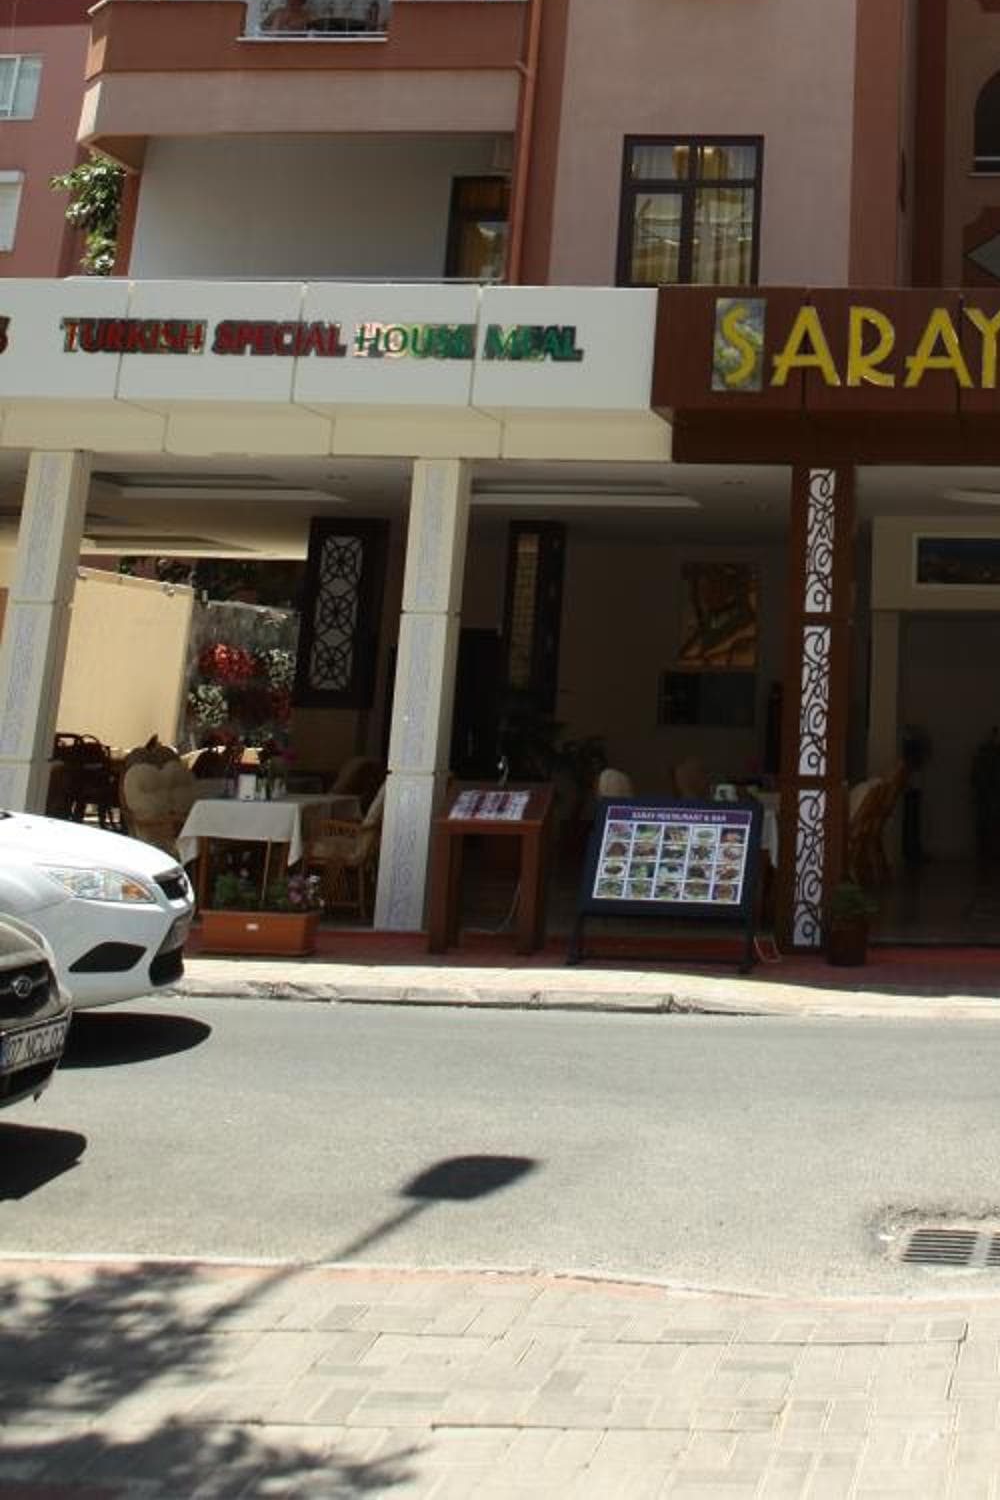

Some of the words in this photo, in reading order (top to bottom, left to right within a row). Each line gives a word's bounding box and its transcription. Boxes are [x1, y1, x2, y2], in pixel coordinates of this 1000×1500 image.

[61, 318, 206, 354] TURKISH
[212, 320, 347, 357] SPECIAL
[353, 322, 477, 359] HOUSE
[482, 324, 583, 361] MEAL
